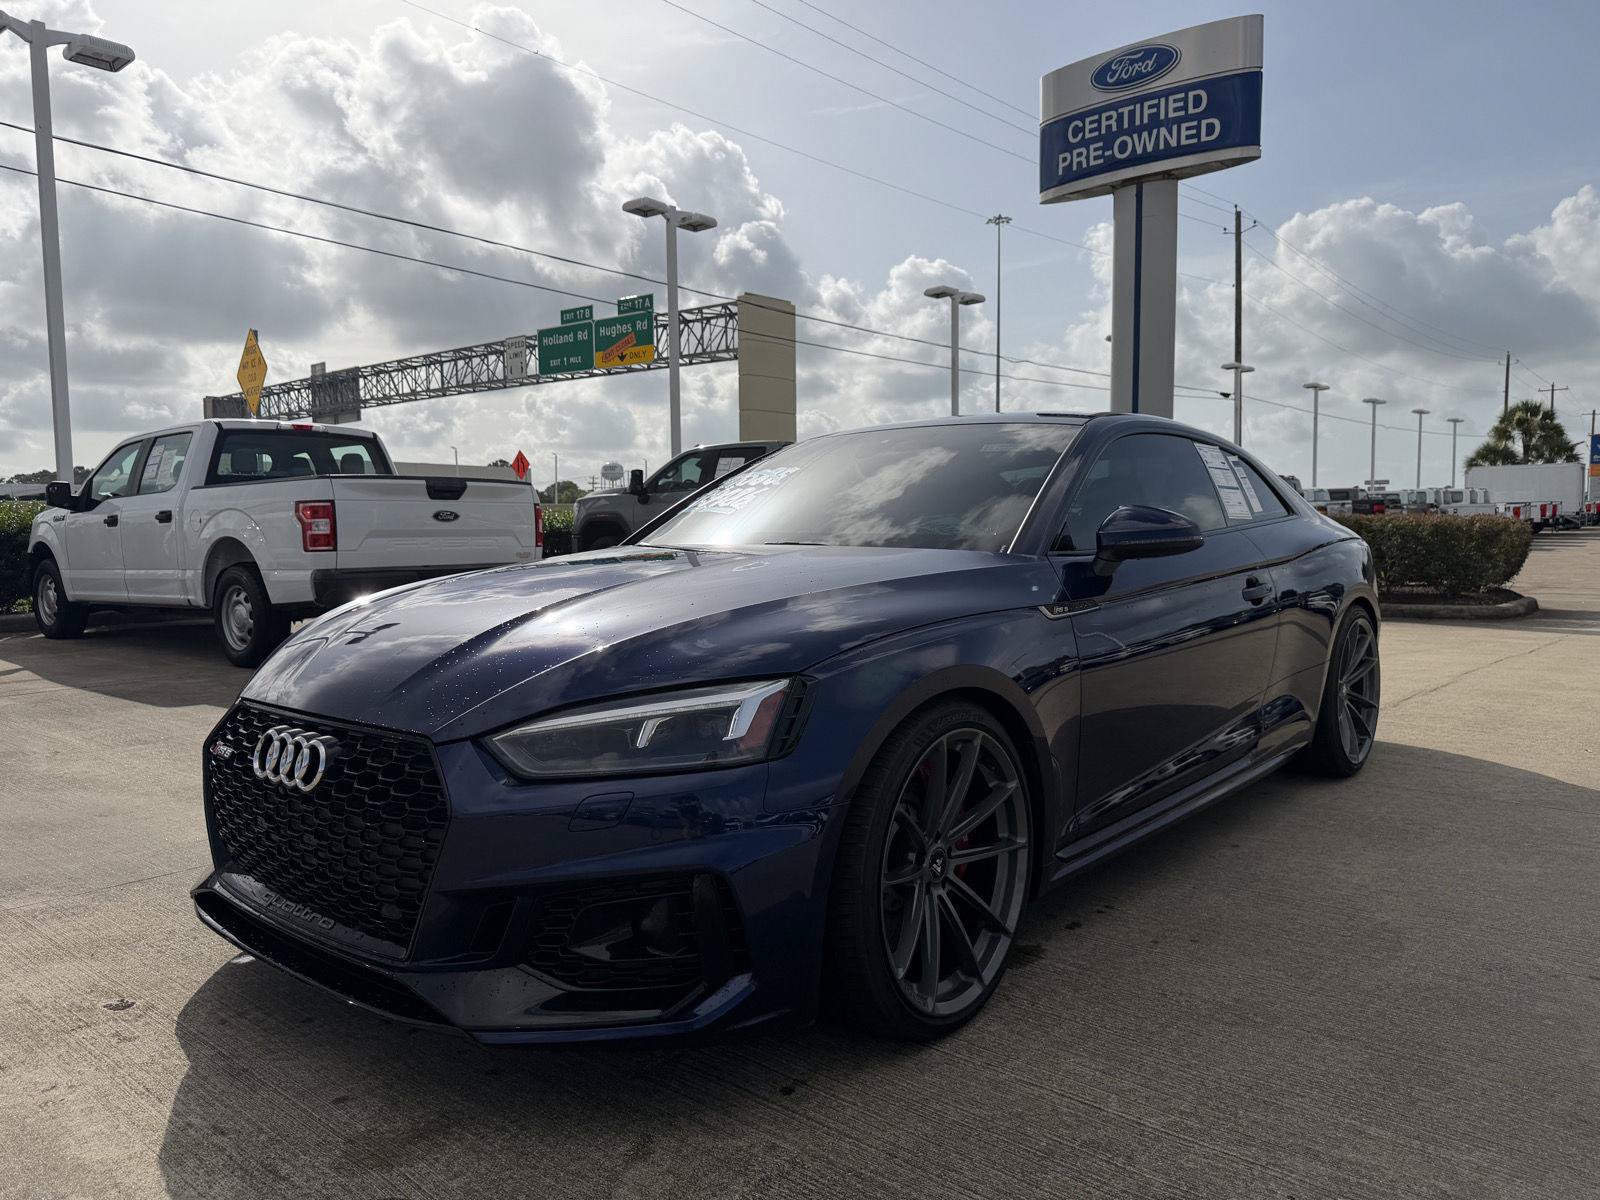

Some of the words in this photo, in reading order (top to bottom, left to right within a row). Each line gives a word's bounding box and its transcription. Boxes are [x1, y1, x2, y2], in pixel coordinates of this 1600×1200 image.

[1106, 51, 1158, 84] Ford
[1067, 88, 1208, 145] CERTIFIED
[1057, 117, 1222, 176] PRE-OWNED
[563, 313, 575, 321] EXIT
[599, 323, 633, 338] Hughes
[636, 319, 648, 331] Rd
[507, 340, 524, 349] SPEED
[542, 334, 574, 346] Holland
[577, 330, 588, 341] Rd
[509, 351, 523, 359] LIMIT
[629, 350, 647, 359] ONLY
[550, 359, 561, 367] EXIT
[569, 356, 582, 364] MILE
[438, 511, 455, 521] Ford
[262, 893, 335, 929] quattro
